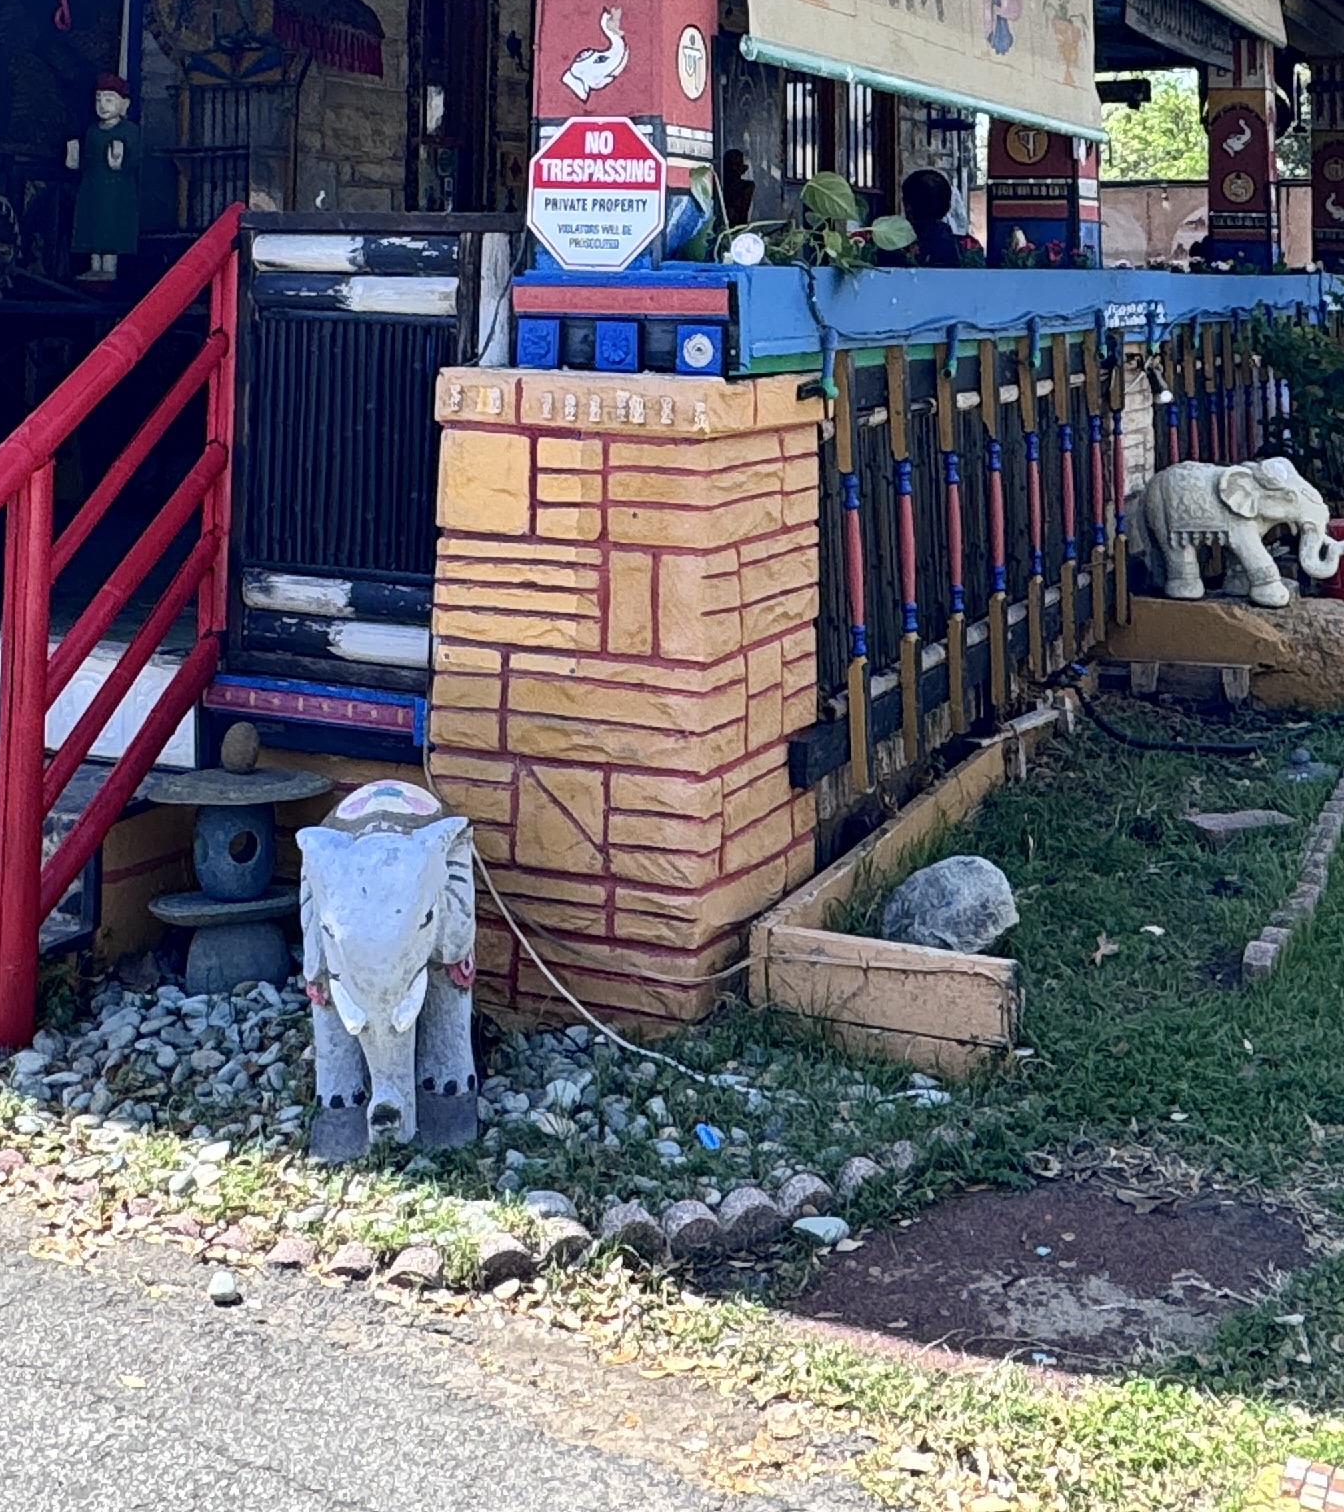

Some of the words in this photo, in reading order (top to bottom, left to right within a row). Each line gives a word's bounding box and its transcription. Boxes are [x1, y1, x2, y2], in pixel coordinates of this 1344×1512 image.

[584, 130, 614, 155] NO
[539, 158, 656, 184] TRESPASSING
[544, 197, 588, 212] PRIVATE
[591, 198, 648, 213] PROPERTY
